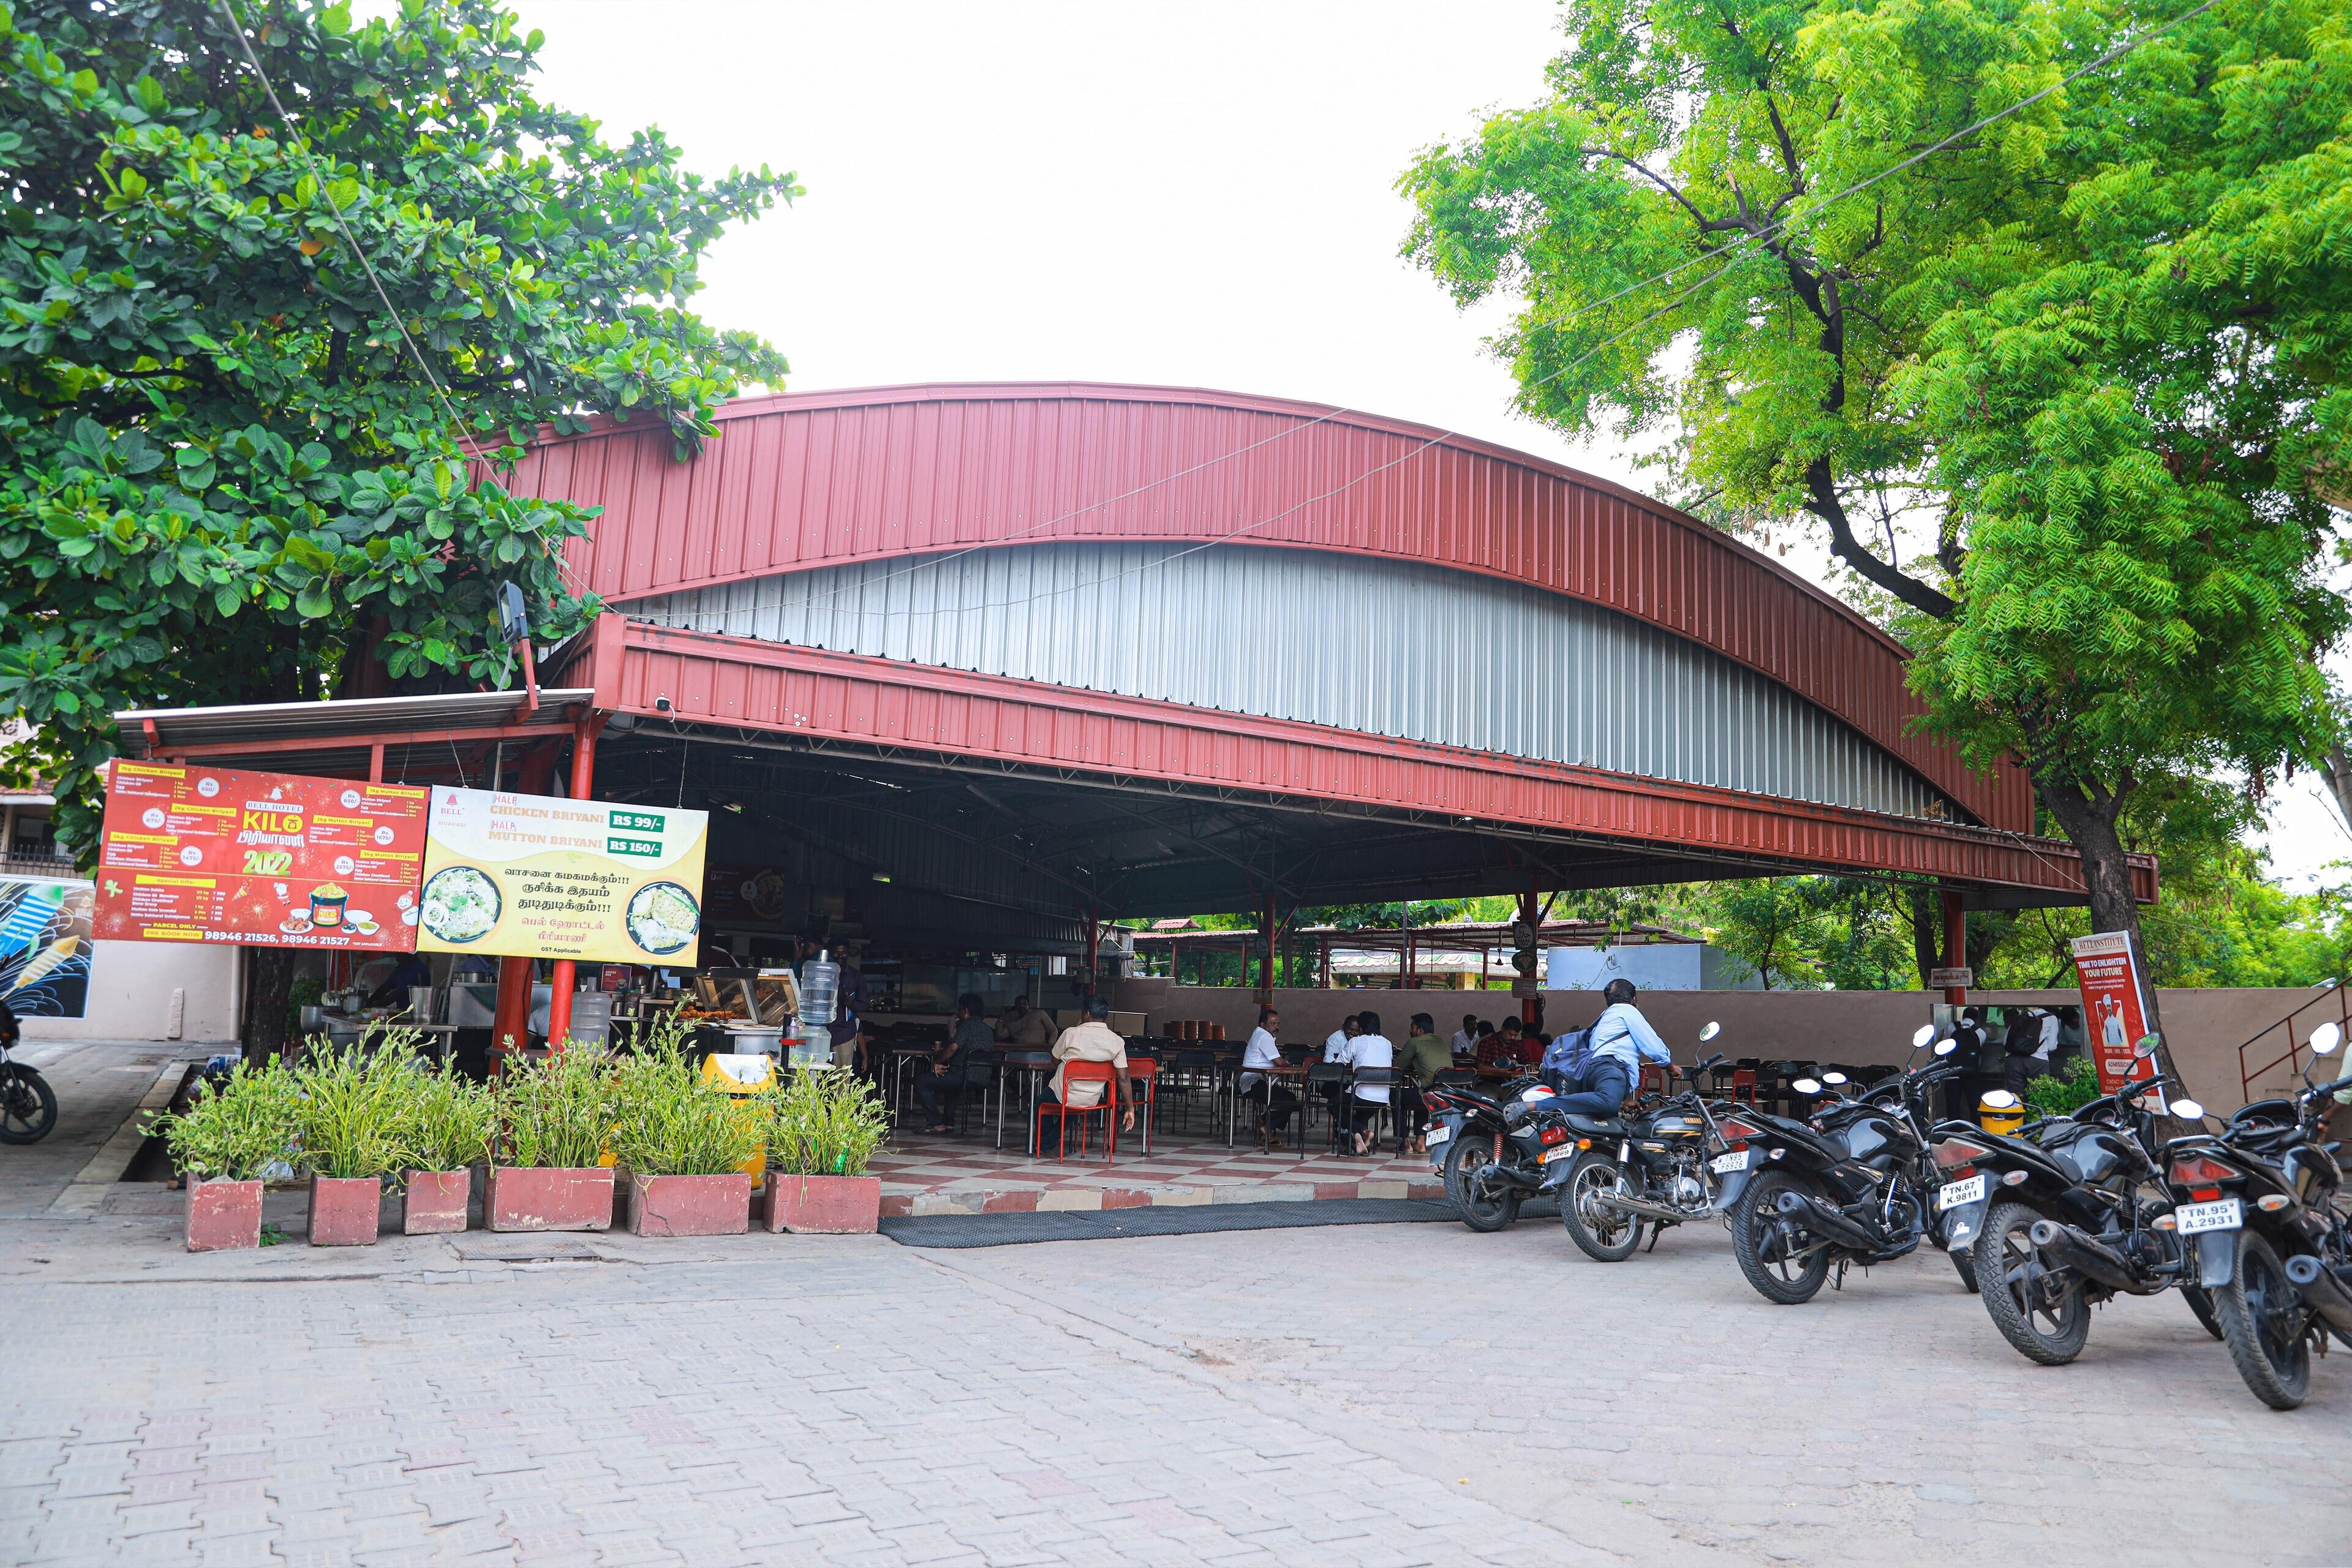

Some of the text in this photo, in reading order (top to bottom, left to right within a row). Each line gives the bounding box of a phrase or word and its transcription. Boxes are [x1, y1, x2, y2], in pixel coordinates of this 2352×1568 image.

[493, 794, 517, 805] HALF
[272, 804, 302, 812] HOTEL
[441, 807, 462, 816] BELL
[243, 811, 303, 833] KILO
[490, 805, 662, 829] CHICKEN BRIYANI RS 99/-
[489, 831, 659, 855] MUTTON BRIYANI RS 150/-
[243, 850, 293, 875] 2022
[505, 869, 551, 878] வாசனை
[522, 882, 610, 898] ருசிக்க இதயம்
[522, 916, 605, 930] பெல் ஹோட்டல்
[205, 931, 242, 941] 98946
[244, 932, 279, 944] 21526,
[282, 935, 317, 943] 98946
[320, 936, 350, 946] 21527
[538, 931, 587, 943] பிரியாணி
[2079, 940, 2095, 949] BELL
[2095, 937, 2124, 948] INSTITUTE
[2078, 960, 2091, 969] TIME
[2098, 957, 2127, 968] ENLIGHTEN
[2084, 967, 2123, 978] YOUR FUTURE
[1431, 1133, 1446, 1144] E6787
[1721, 1160, 1743, 1170] F6926
[1949, 1182, 1975, 1195] TN.67
[1947, 1190, 1977, 1204] K.9811
[2188, 1205, 2228, 1218] TN.95
[2185, 1215, 2233, 1229] A.2931
